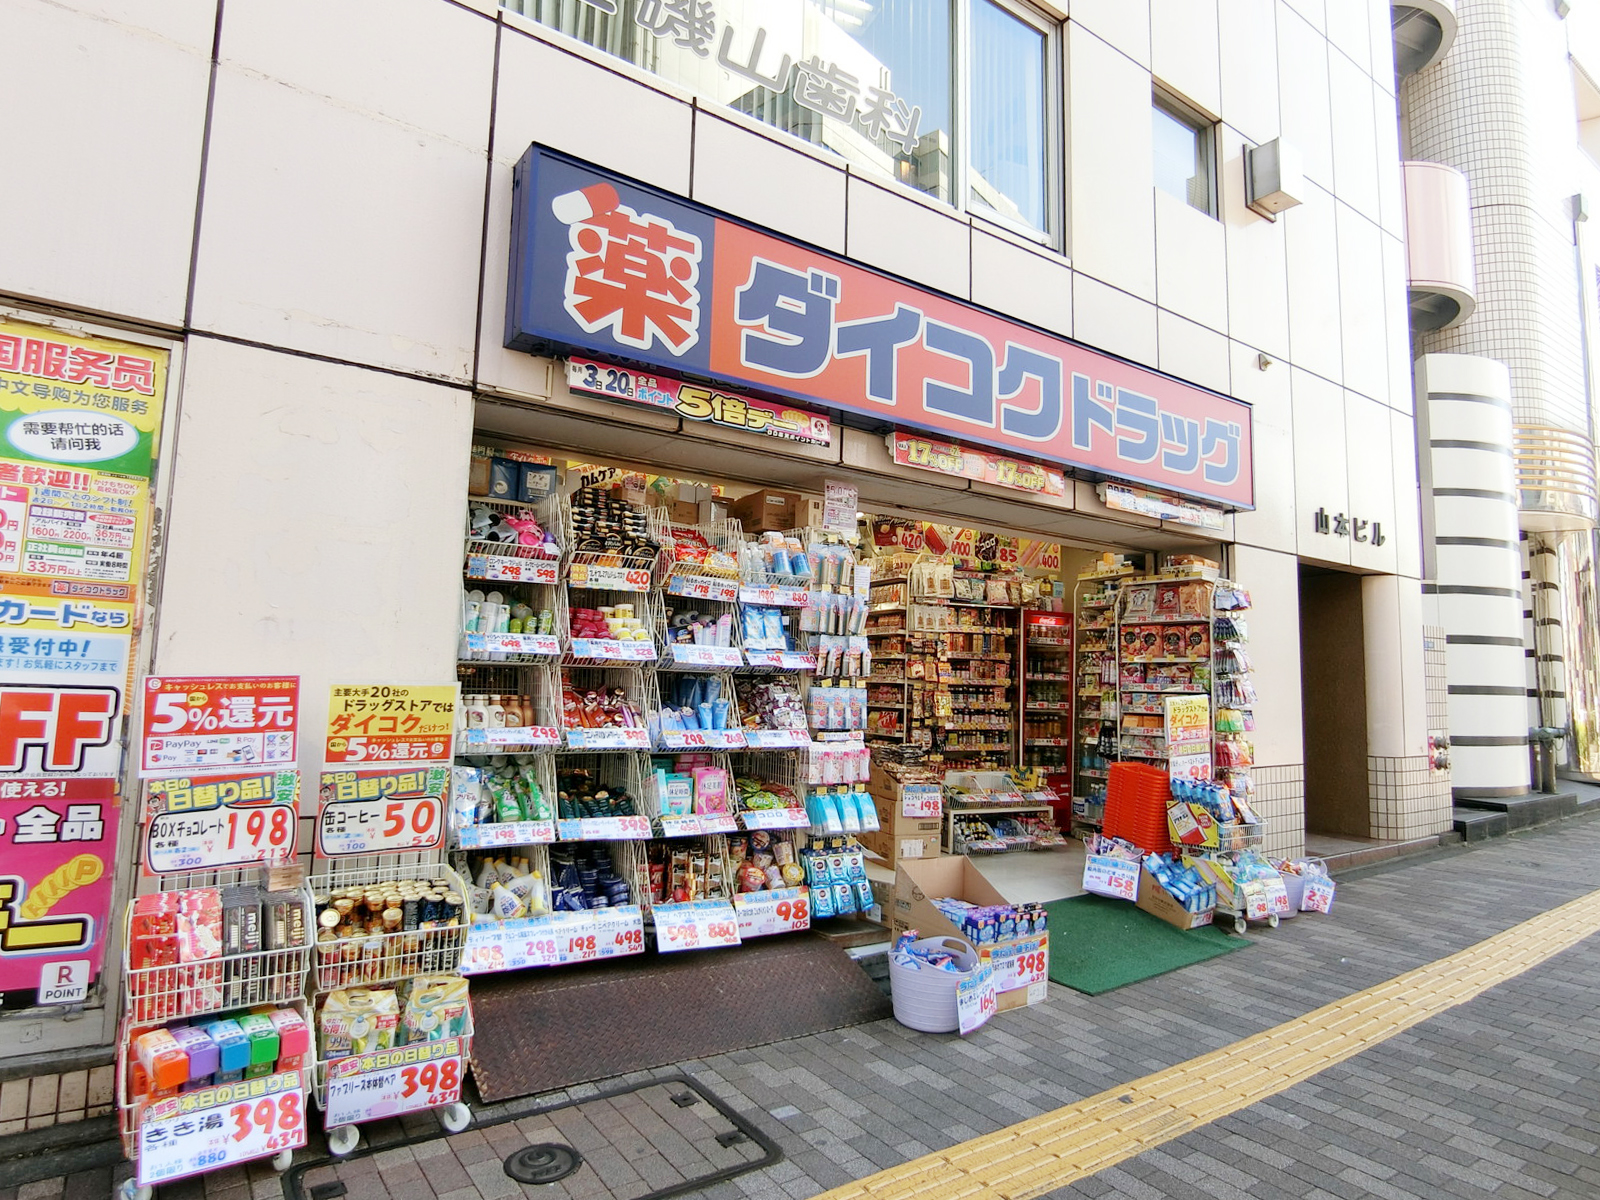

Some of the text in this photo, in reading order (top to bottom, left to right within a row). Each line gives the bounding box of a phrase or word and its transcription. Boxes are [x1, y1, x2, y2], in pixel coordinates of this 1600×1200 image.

[556, 190, 702, 357] 薬
[734, 256, 1244, 487] ダイコクドラッグ
[637, 376, 658, 389] 全品
[637, 388, 674, 406] ポイント
[677, 385, 799, 433] 5倍デー
[23, 421, 124, 438] 需要帮忙的话
[50, 437, 102, 452] 请问我
[1315, 507, 1386, 547] 山本ビル
[902, 532, 923, 550] 420
[1000, 548, 1018, 562] 85
[1042, 555, 1060, 569] 400
[27, 561, 82, 577] 33万円以上
[501, 565, 522, 576] 298
[536, 568, 556, 579] 598
[625, 571, 650, 585] 420
[693, 584, 710, 594] 178
[720, 588, 735, 598] 198
[151, 692, 293, 732] 5%還元
[344, 699, 454, 713] ドラッグストアでは
[331, 713, 421, 735] ダイコク
[530, 727, 560, 740] 298
[623, 730, 648, 742] 398
[682, 733, 705, 746] 298
[165, 739, 202, 749] PayPay
[345, 737, 428, 761] 5%還元
[167, 776, 273, 812] 日替り品!
[337, 771, 425, 800] 日替り品!
[919, 800, 940, 811] 198
[383, 800, 435, 838] 50
[617, 817, 650, 833] 398
[227, 808, 288, 850] 198
[494, 829, 517, 840] 198
[412, 835, 436, 846] 54
[178, 856, 202, 866] 300
[257, 847, 288, 860] 213
[1107, 874, 1134, 893] 158
[776, 899, 808, 922] 98
[245, 912, 259, 944] meiji
[707, 921, 737, 939] 880
[791, 919, 808, 930] 105
[568, 935, 597, 953] 198
[615, 929, 643, 946] 498
[526, 939, 556, 956] 298
[1016, 951, 1045, 976] 398
[45, 987, 83, 999] POINT
[401, 1058, 459, 1099] 398
[180, 1072, 301, 1113] 本日の日替り品
[428, 1089, 459, 1105] 437
[230, 1091, 302, 1143] 398
[145, 1112, 225, 1144] きき湯
[266, 1128, 303, 1150] 437
[197, 1149, 227, 1167] 880
